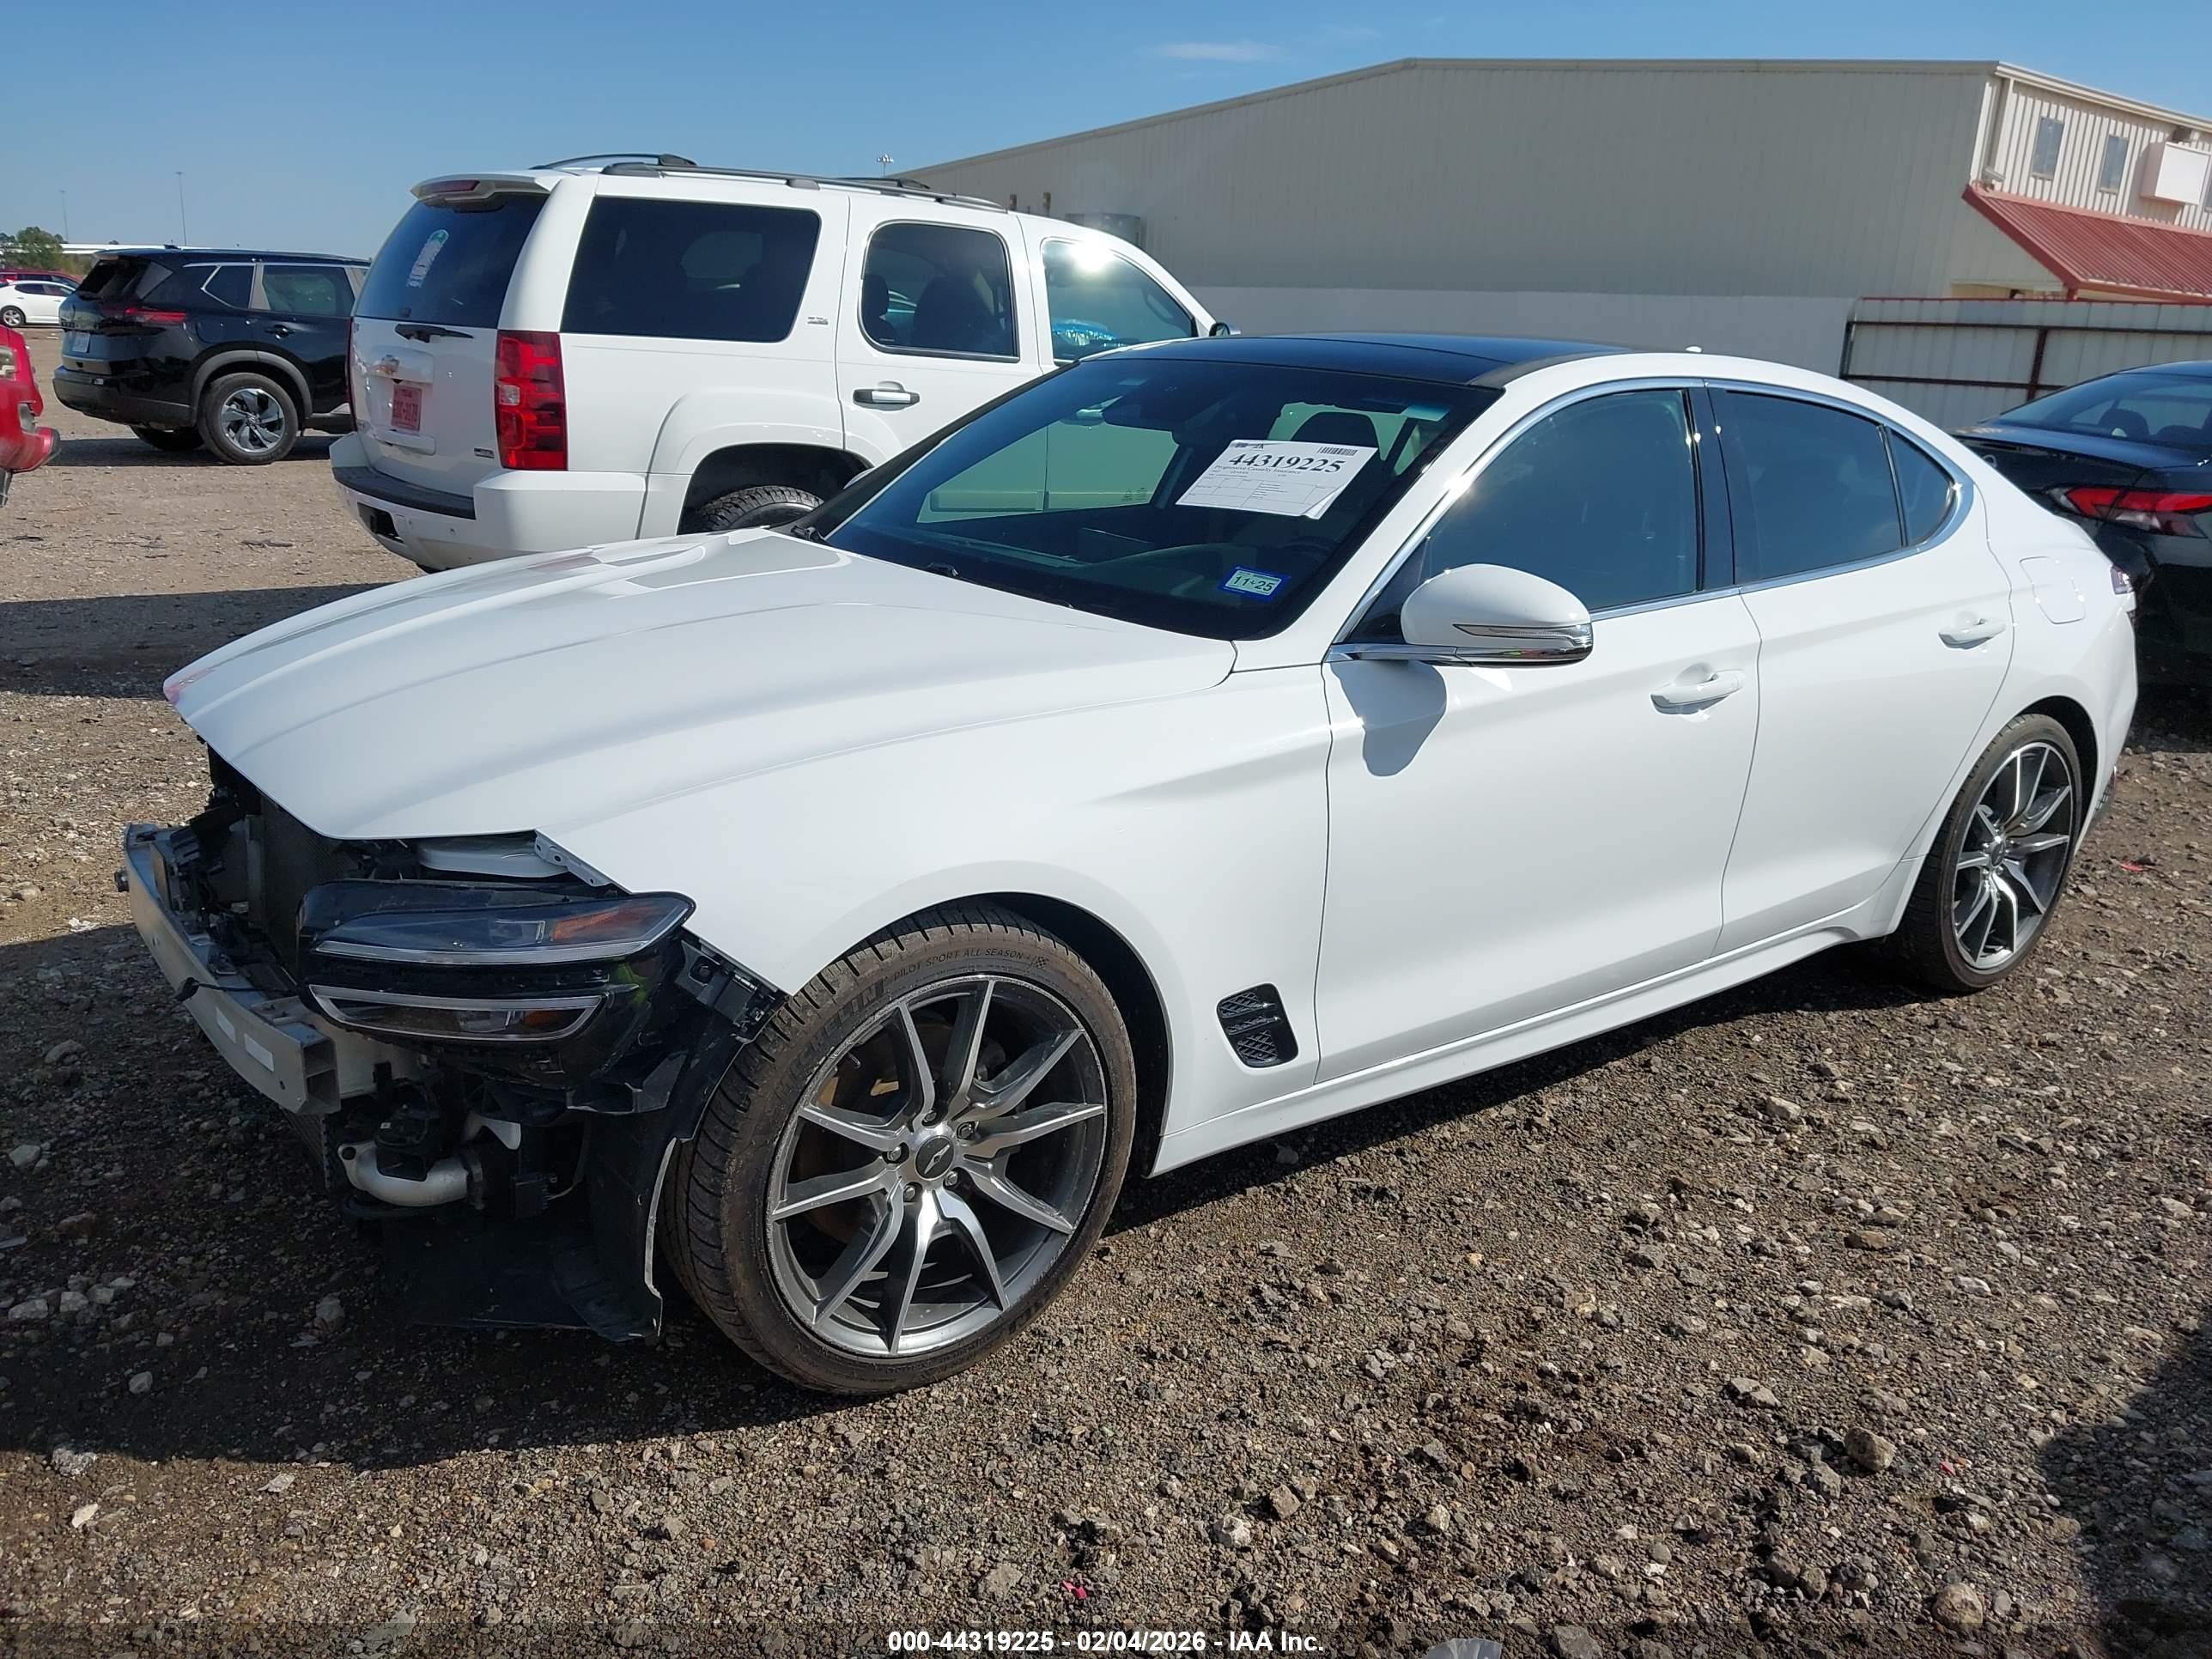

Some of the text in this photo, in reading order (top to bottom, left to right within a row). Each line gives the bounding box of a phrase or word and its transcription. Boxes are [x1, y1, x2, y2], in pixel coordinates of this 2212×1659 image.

[1230, 453, 1346, 473] 44319225
[1255, 580, 1276, 592] 25
[894, 962, 921, 980] PILOT
[927, 951, 960, 967] SPORT
[963, 947, 981, 957] ALL
[985, 948, 1024, 960] SEASON
